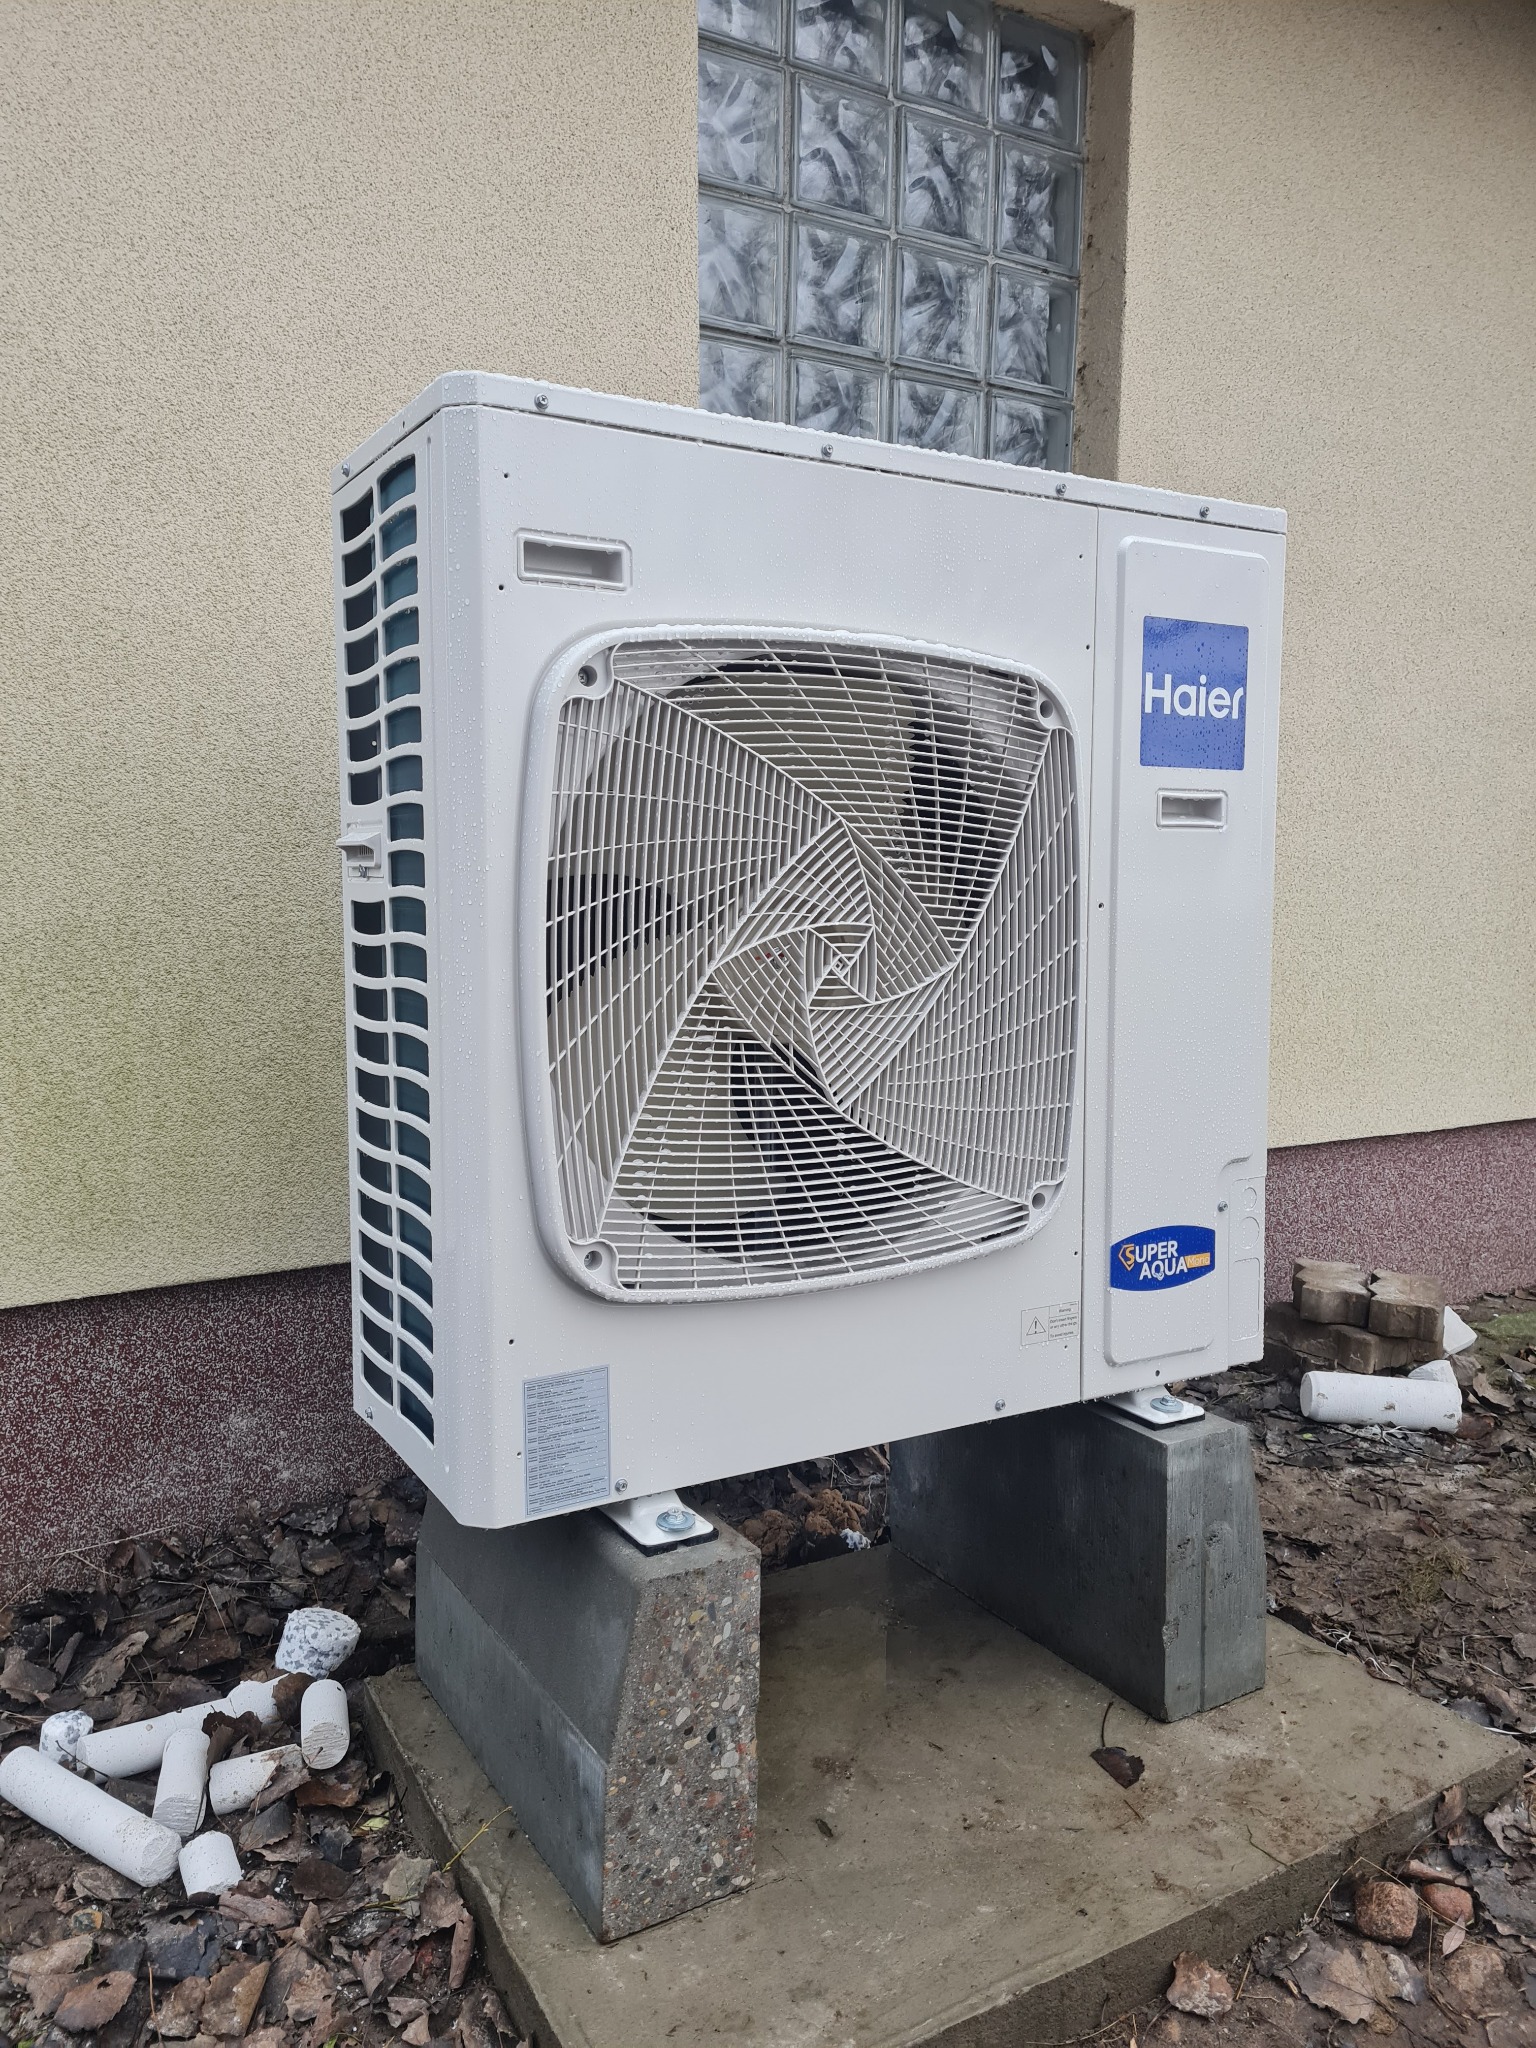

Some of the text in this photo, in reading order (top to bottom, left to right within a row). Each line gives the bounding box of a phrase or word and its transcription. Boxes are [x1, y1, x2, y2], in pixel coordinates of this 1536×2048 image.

[1144, 672, 1244, 719] Haier
[1124, 1241, 1178, 1265] SUPER
[1139, 1256, 1210, 1281] AQUA Mono
